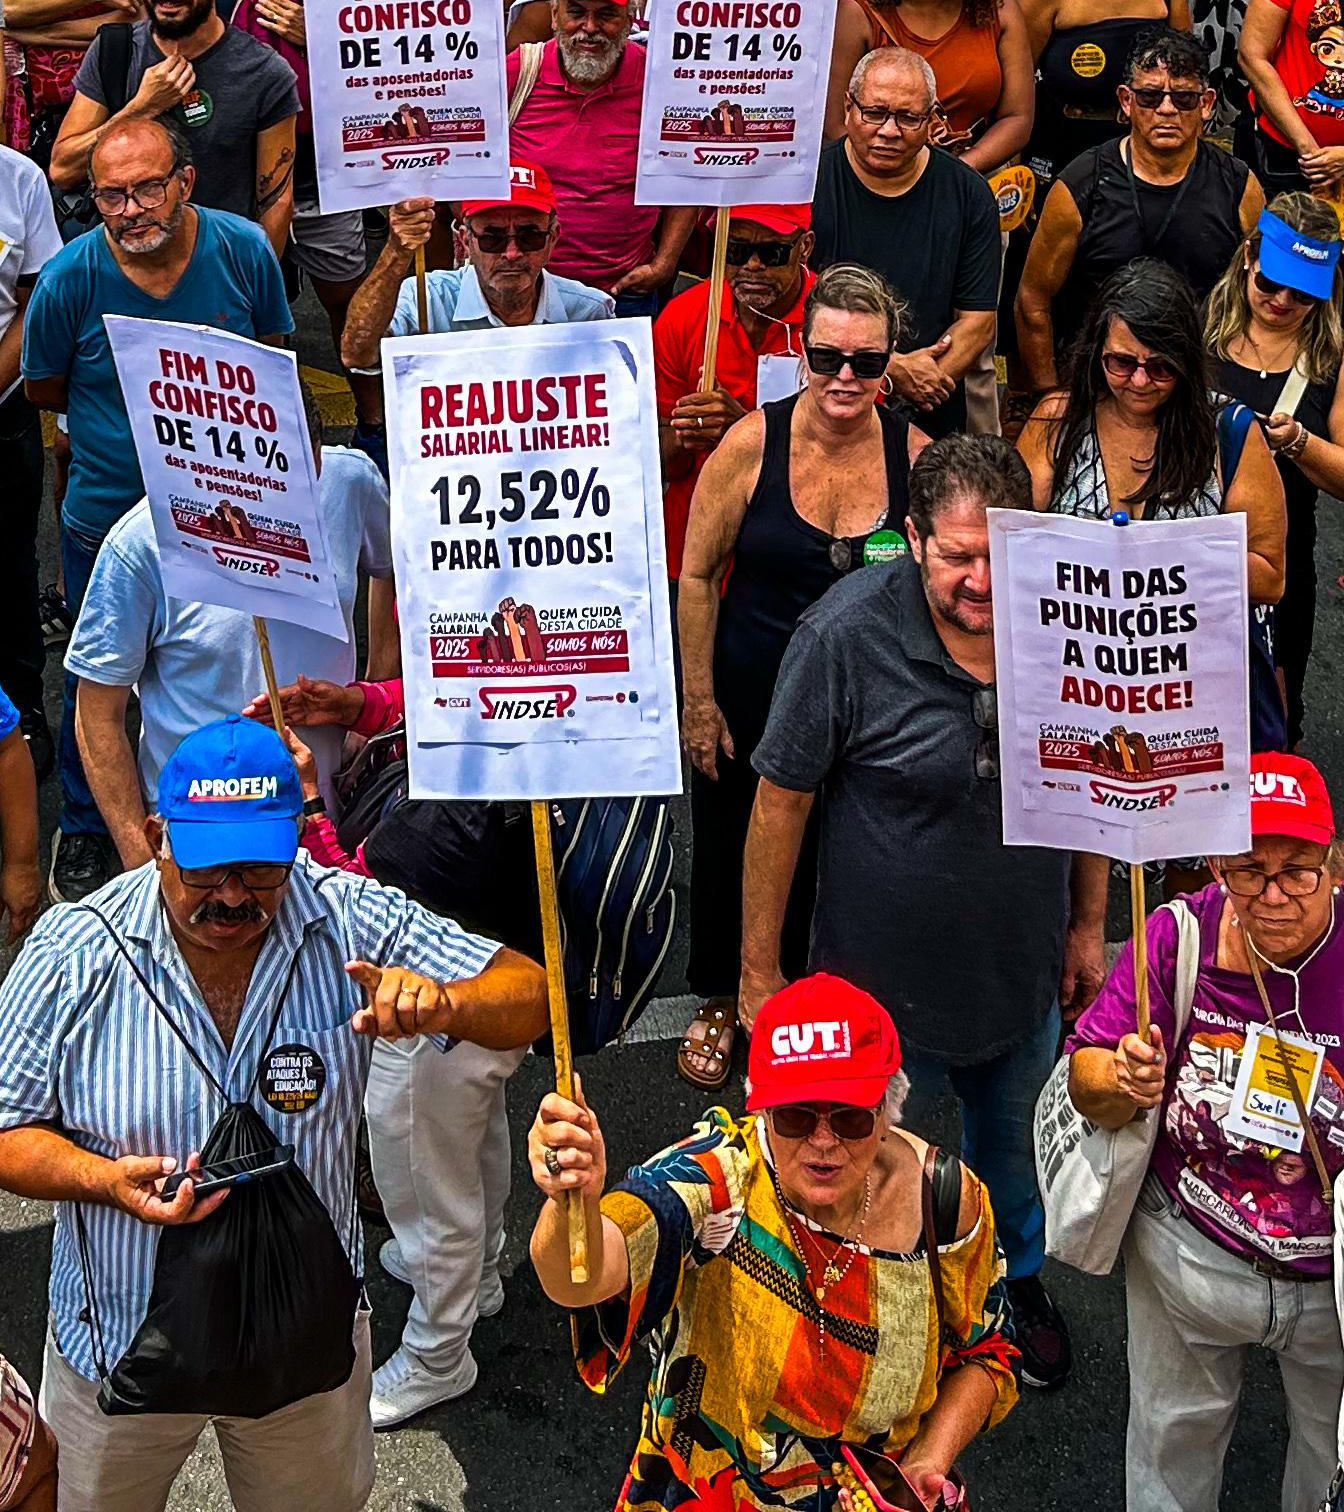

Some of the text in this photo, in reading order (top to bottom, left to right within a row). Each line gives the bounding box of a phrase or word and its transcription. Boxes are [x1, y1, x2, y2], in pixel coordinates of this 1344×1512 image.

[676, 0, 802, 29] CONFISCO
[672, 32, 802, 62] DE 14 %
[345, 68, 474, 89] das aposentadorias
[673, 67, 794, 82] das aposentadorias
[419, 373, 609, 430] REAJUSTE
[420, 421, 610, 458] SALARIAL LINEAR!
[430, 466, 611, 530] 12,52%
[430, 531, 615, 571] PARA TODOS!
[1056, 560, 1187, 600] FIM DAS
[429, 605, 622, 625] CAMPANHA QUEM CUIDA
[430, 616, 623, 635] SALARIAL DESTA CIDADE
[1039, 597, 1198, 645] PUNIÇÕES
[435, 638, 470, 658] 2025
[546, 636, 599, 653] SOMOS
[1063, 638, 1188, 677] A QUEM
[479, 684, 576, 721] SINDSEP
[1060, 675, 1193, 715] ADOECE!
[187, 775, 278, 800] APROFEM
[770, 1021, 844, 1054] CUT
[266, 1069, 301, 1080] ATAQUES
[270, 1056, 301, 1068] CONTRA
[1249, 1094, 1287, 1116] Sueli
